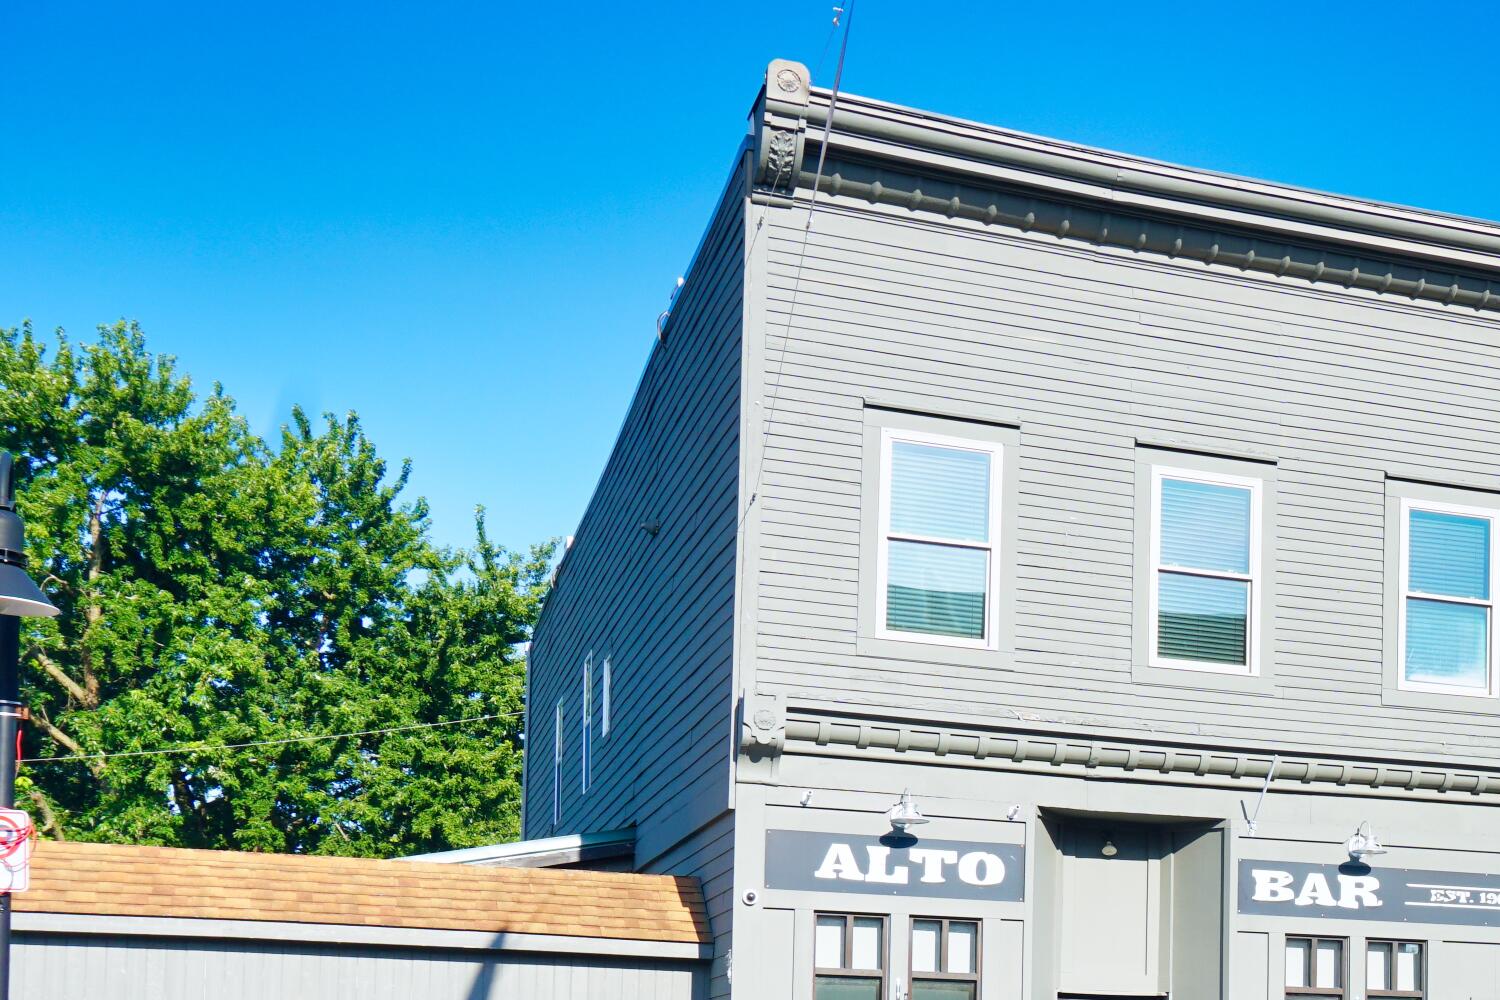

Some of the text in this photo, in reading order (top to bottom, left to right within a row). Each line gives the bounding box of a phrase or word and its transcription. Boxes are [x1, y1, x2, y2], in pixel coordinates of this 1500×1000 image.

[814, 843, 1006, 886] ALTO
[1251, 868, 1383, 909] BAR
[1430, 889, 1474, 904] EST.
